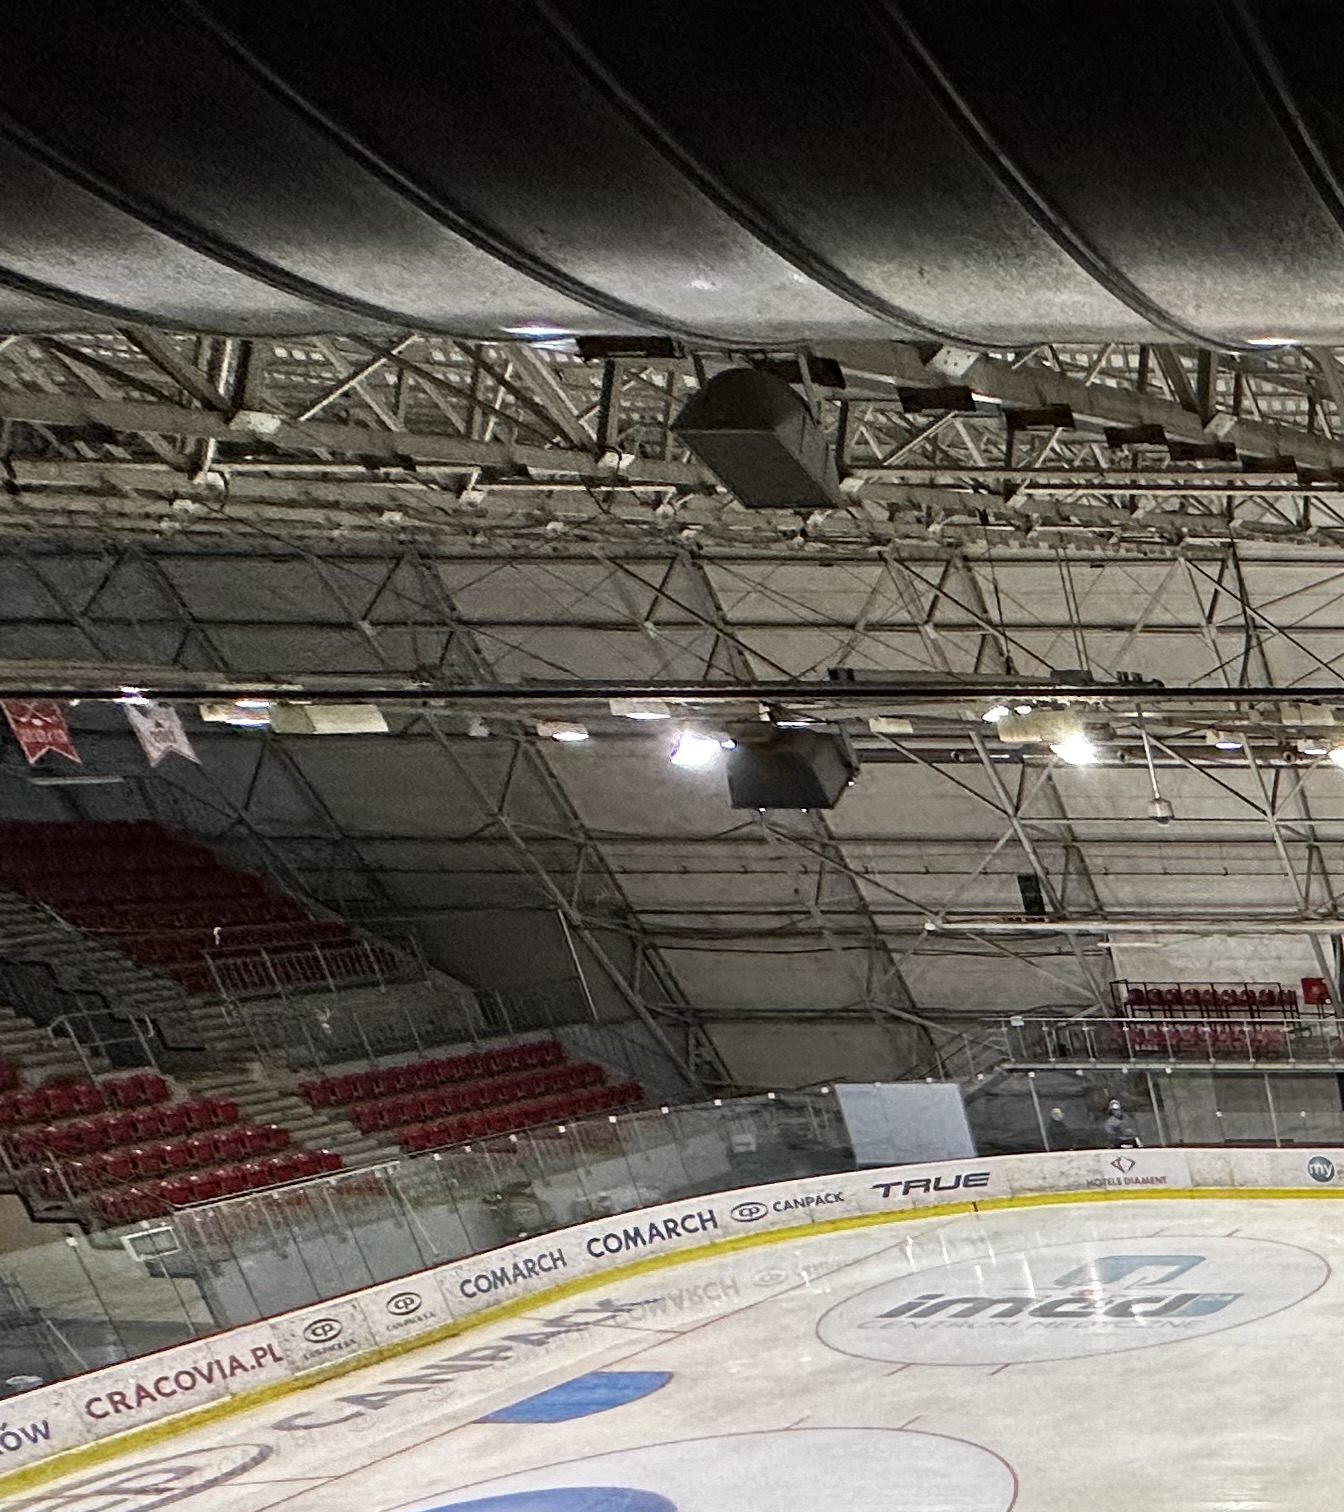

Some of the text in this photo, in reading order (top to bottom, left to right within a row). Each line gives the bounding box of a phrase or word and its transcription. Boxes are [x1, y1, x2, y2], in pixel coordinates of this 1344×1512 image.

[871, 1172, 990, 1198] TRUE
[1308, 1163, 1333, 1178] my
[773, 1191, 846, 1213] CANPACK
[587, 1208, 719, 1258] COMARCH
[459, 1248, 568, 1299] COMARCH
[85, 1342, 284, 1421] CRACOVIA.PL
[0, 1419, 50, 1455] ÓW
